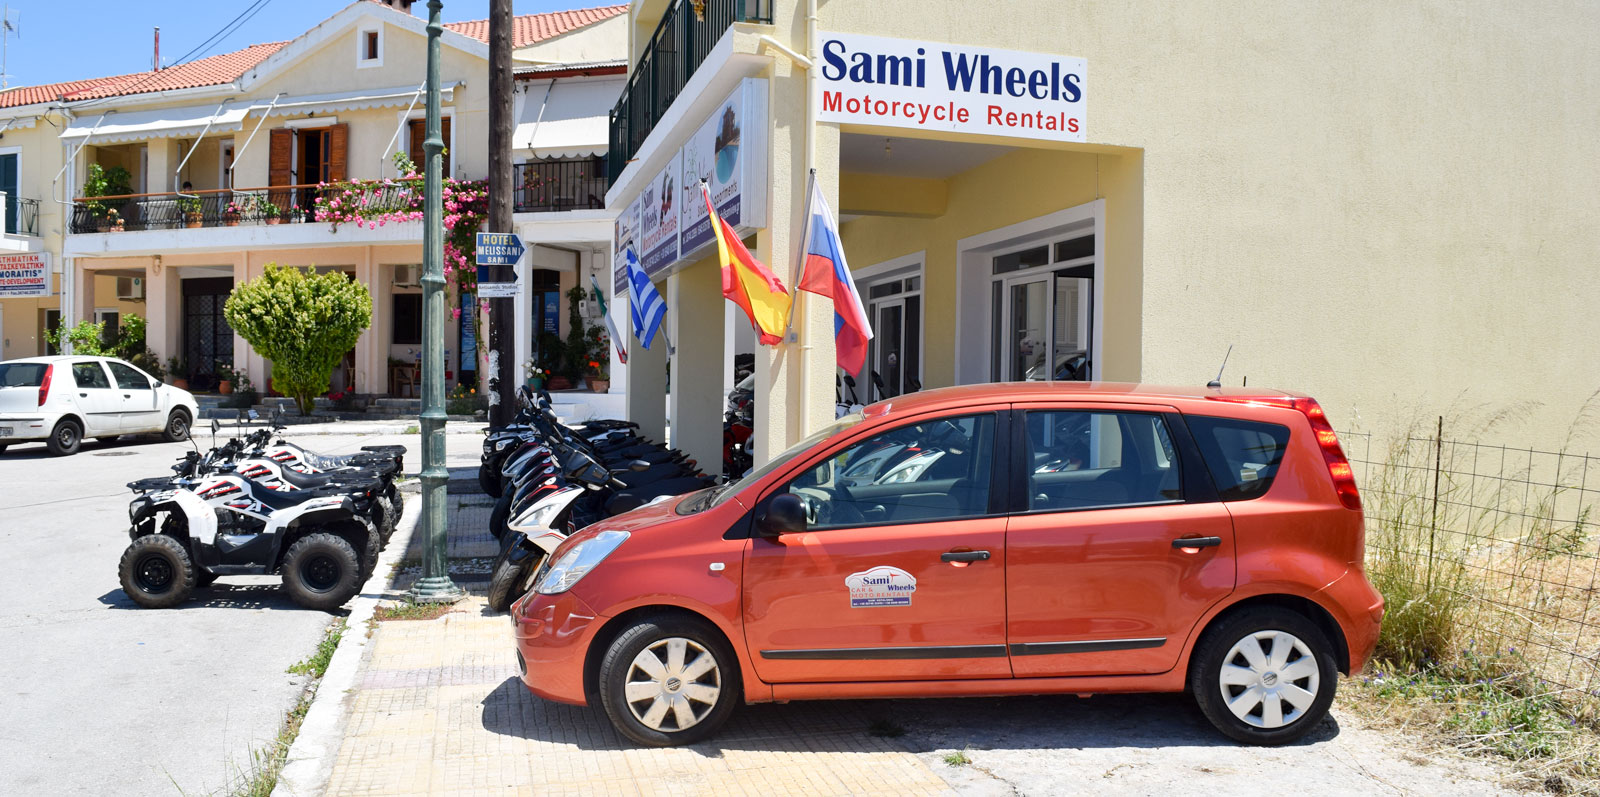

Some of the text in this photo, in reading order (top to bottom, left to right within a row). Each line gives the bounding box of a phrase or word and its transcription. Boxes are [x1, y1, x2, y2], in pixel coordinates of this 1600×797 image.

[821, 39, 1082, 103] Sami Wheels
[823, 90, 1080, 133] Motorcycle Rentals
[482, 235, 515, 246] HOTEL
[478, 246, 521, 256] MELISSANI
[863, 575, 890, 585] Sami
